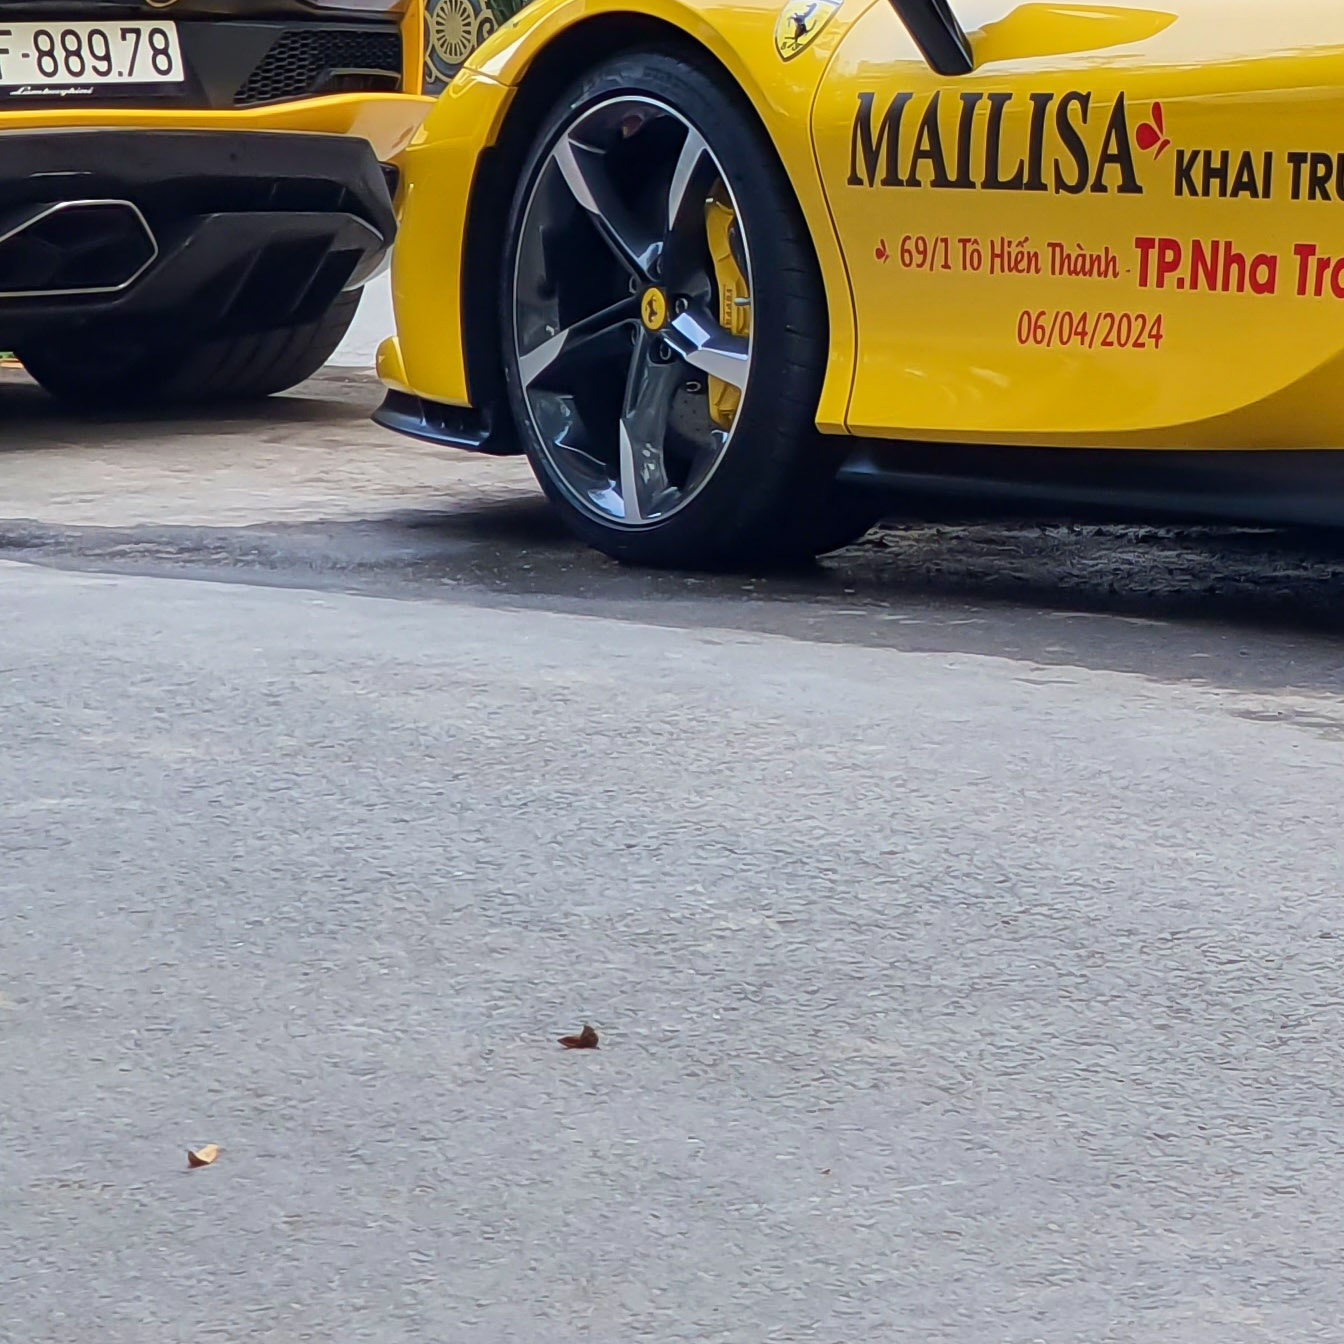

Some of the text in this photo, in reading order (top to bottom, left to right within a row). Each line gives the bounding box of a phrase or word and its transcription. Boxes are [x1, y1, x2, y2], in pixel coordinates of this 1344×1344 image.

[847, 90, 1143, 196] MAILISA
[1174, 148, 1273, 200] KHAI
[900, 234, 952, 273] 69/1
[957, 235, 983, 272] Tô
[988, 236, 1042, 277] Hiến
[1047, 239, 1120, 280] Thành
[1016, 310, 1164, 350] 06/04/2024
